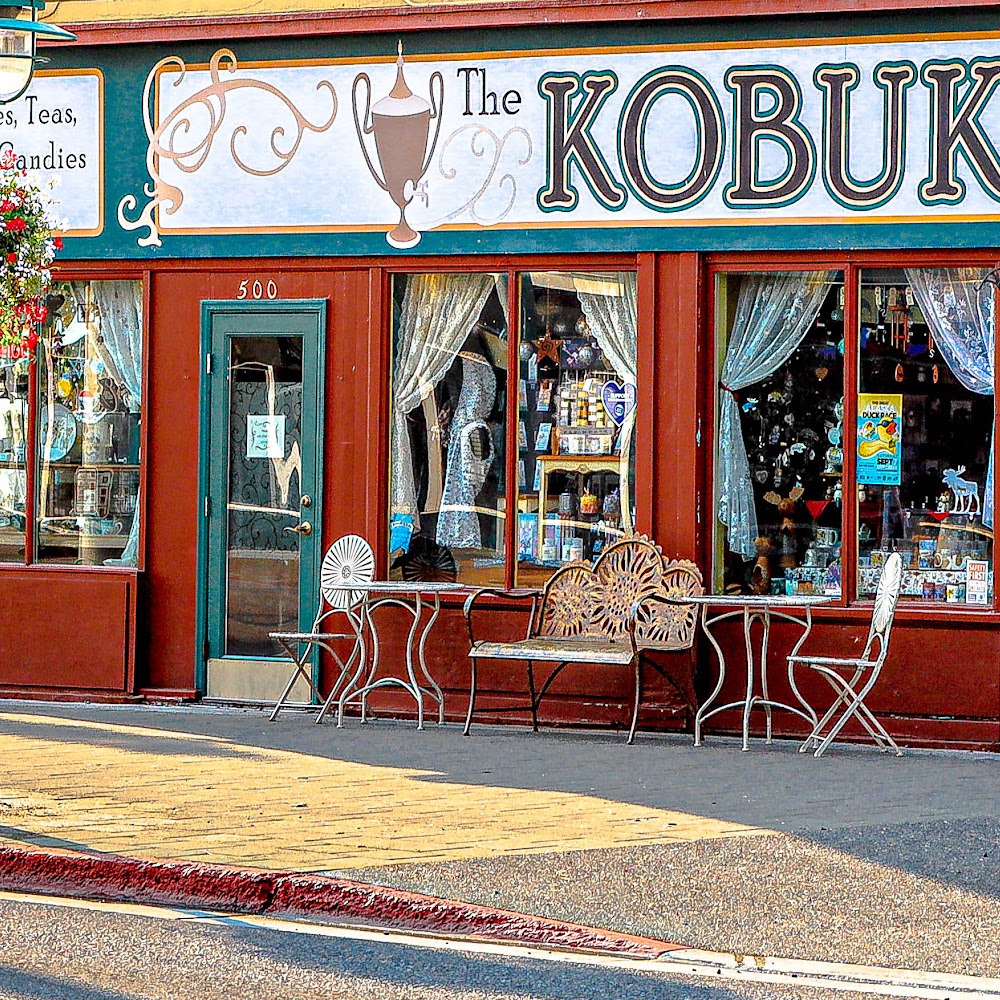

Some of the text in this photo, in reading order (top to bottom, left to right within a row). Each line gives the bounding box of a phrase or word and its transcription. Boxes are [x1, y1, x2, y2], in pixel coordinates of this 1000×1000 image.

[457, 67, 522, 116] The
[25, 95, 77, 127] Teas,
[236, 279, 279, 300] 500
[862, 411, 897, 420] DUCK RACE
[969, 563, 986, 571] SAFETY
[969, 571, 986, 581] FIRST
